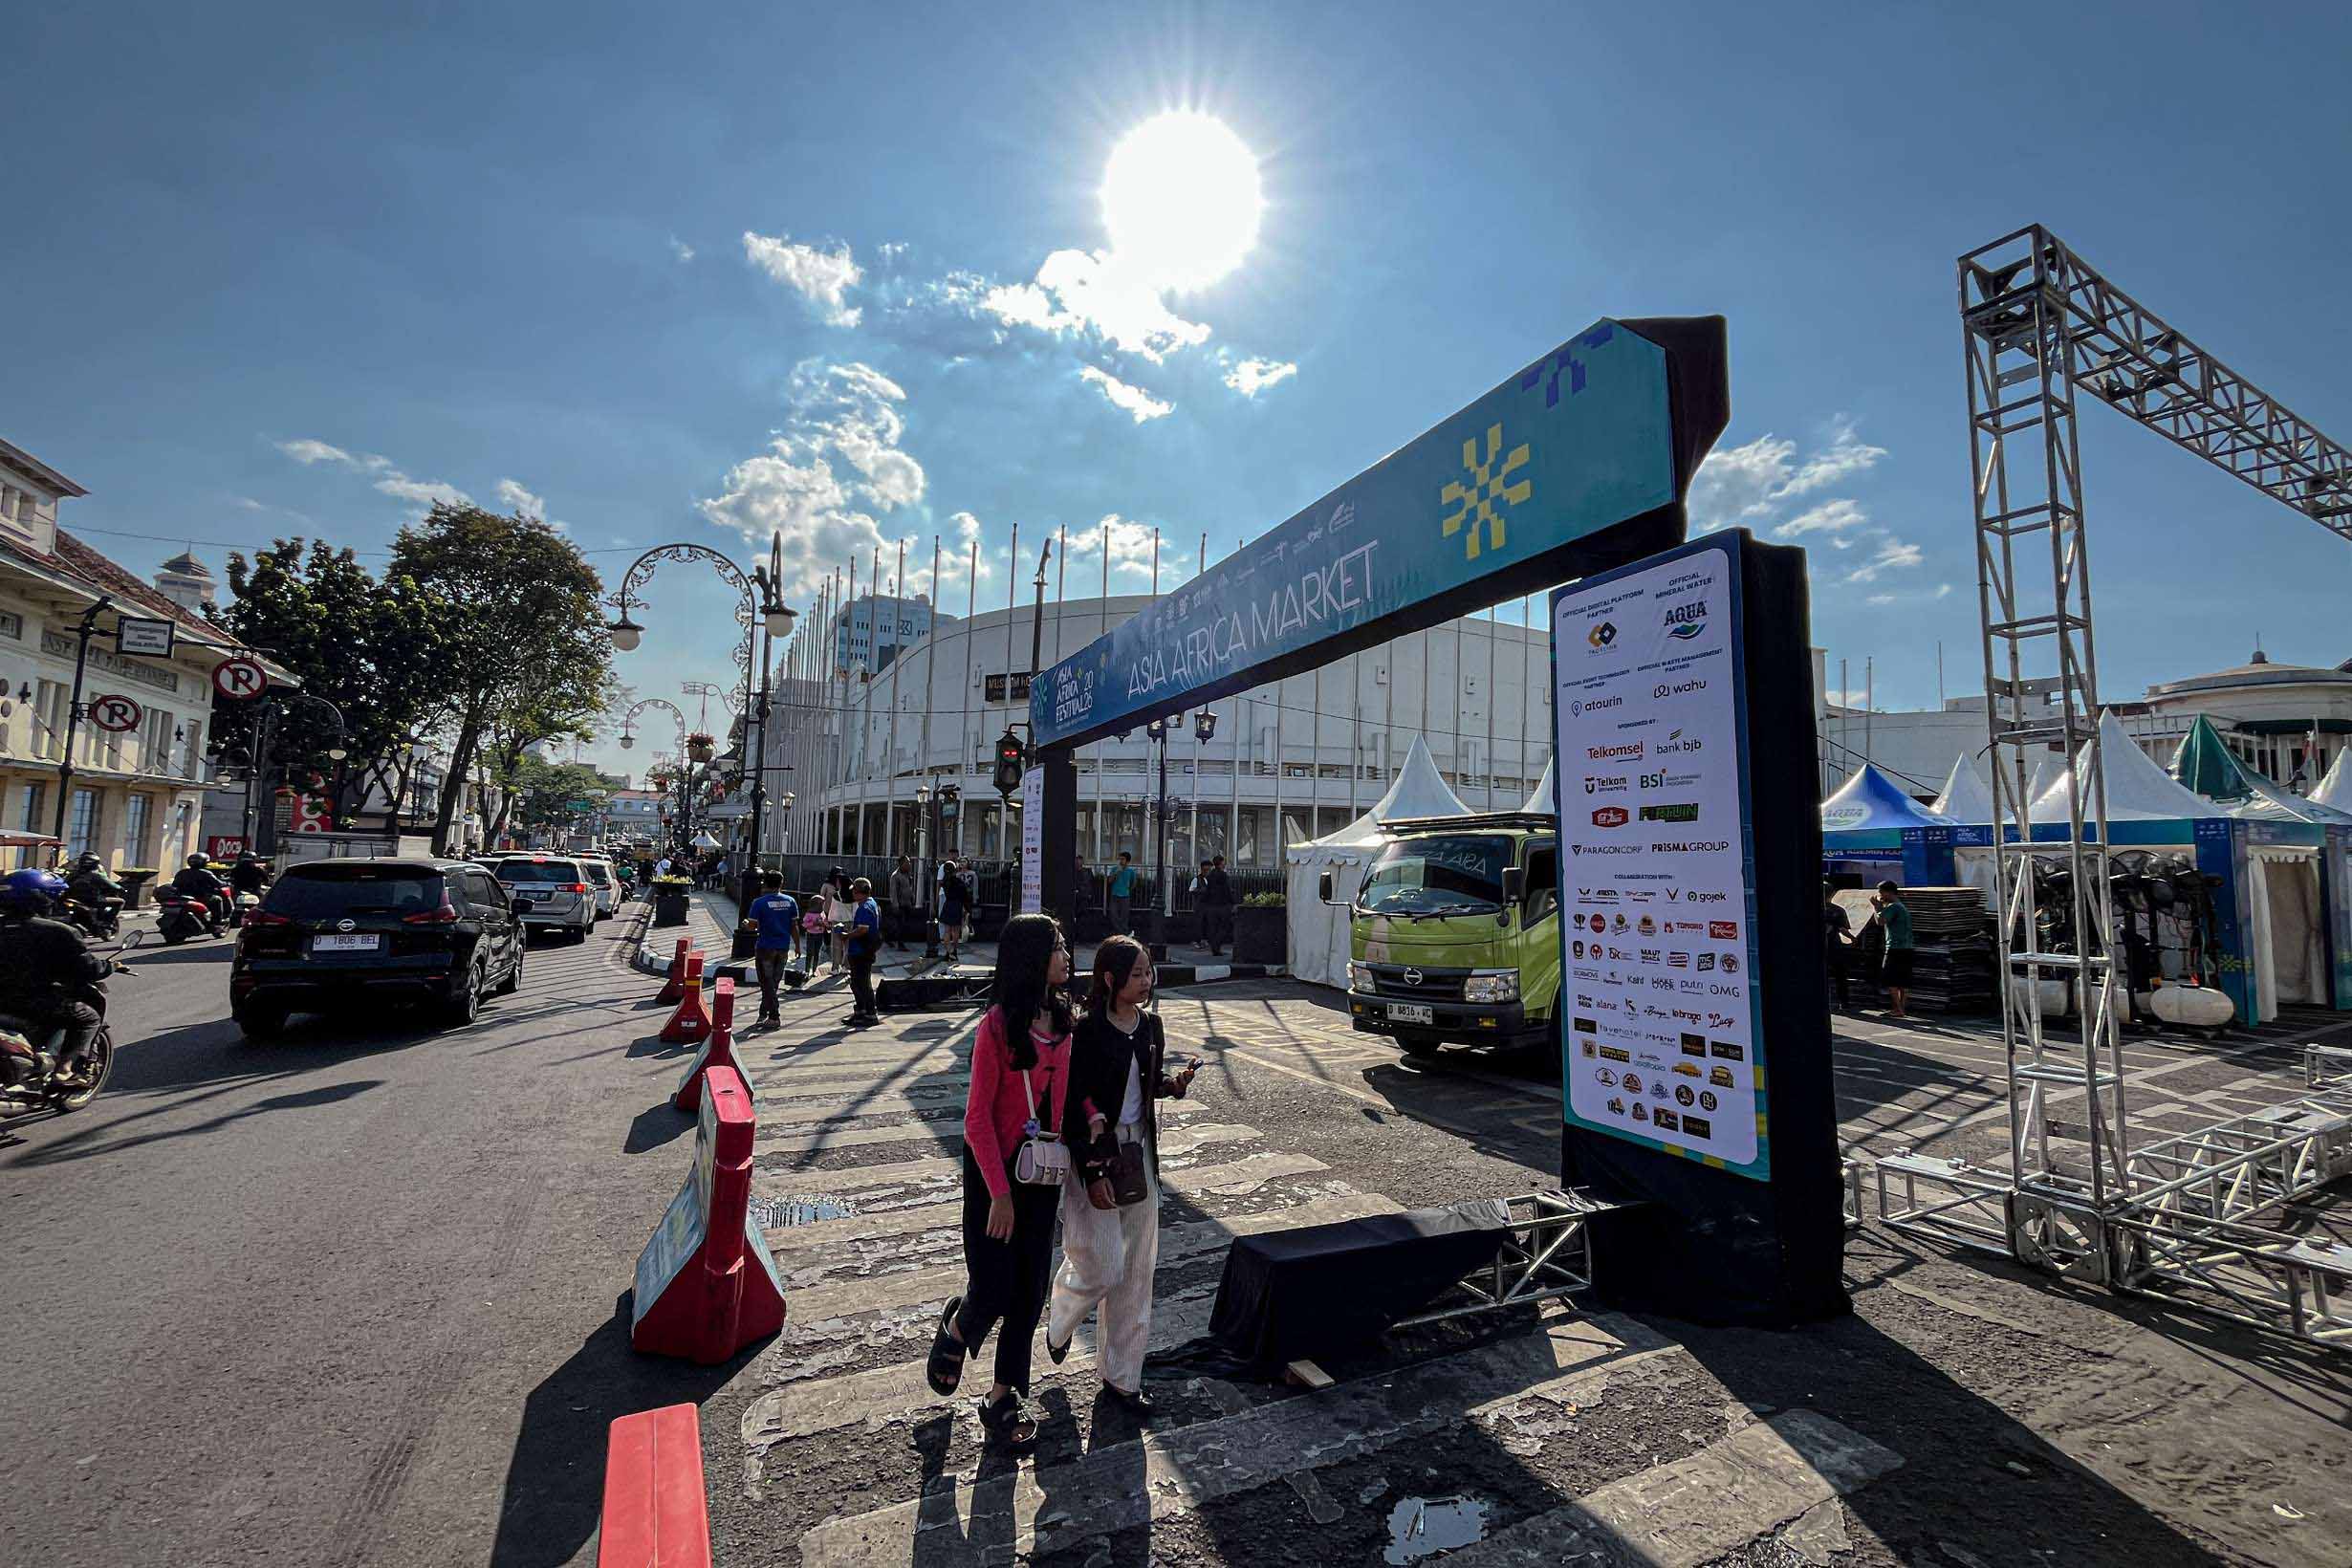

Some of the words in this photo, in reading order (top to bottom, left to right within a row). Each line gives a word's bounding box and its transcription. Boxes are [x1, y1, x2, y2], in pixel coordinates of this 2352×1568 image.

[1668, 572, 1700, 586] OFFICIAL
[1655, 586, 1685, 599] MINERAL
[1687, 577, 1712, 591] WATER
[1562, 606, 1586, 619] OFFICIAL
[1611, 589, 1644, 603] PLATFORM
[1127, 650, 1167, 703] ASIA
[1170, 612, 1247, 682] AFRICA
[1252, 539, 1378, 645] MARKET
[1587, 607, 1614, 620] PARTNER
[1664, 601, 1708, 626] AQUA
[1057, 665, 1073, 686] ASIA
[1056, 680, 1078, 705] AFRICA
[1673, 680, 1707, 693] wahu
[1056, 695, 1084, 724] FESTIVAL
[1585, 696, 1622, 711] atourin
[1588, 741, 1644, 759] Telkomsel
[1657, 742, 1681, 754] bank
[1683, 739, 1702, 752] bjb
[1597, 776, 1627, 786] Telkom
[1640, 770, 1666, 788] BSI
[1582, 845, 1643, 855] PARAGONCORP
[1700, 892, 1727, 903] gojek
[1710, 984, 1740, 997] OMG
